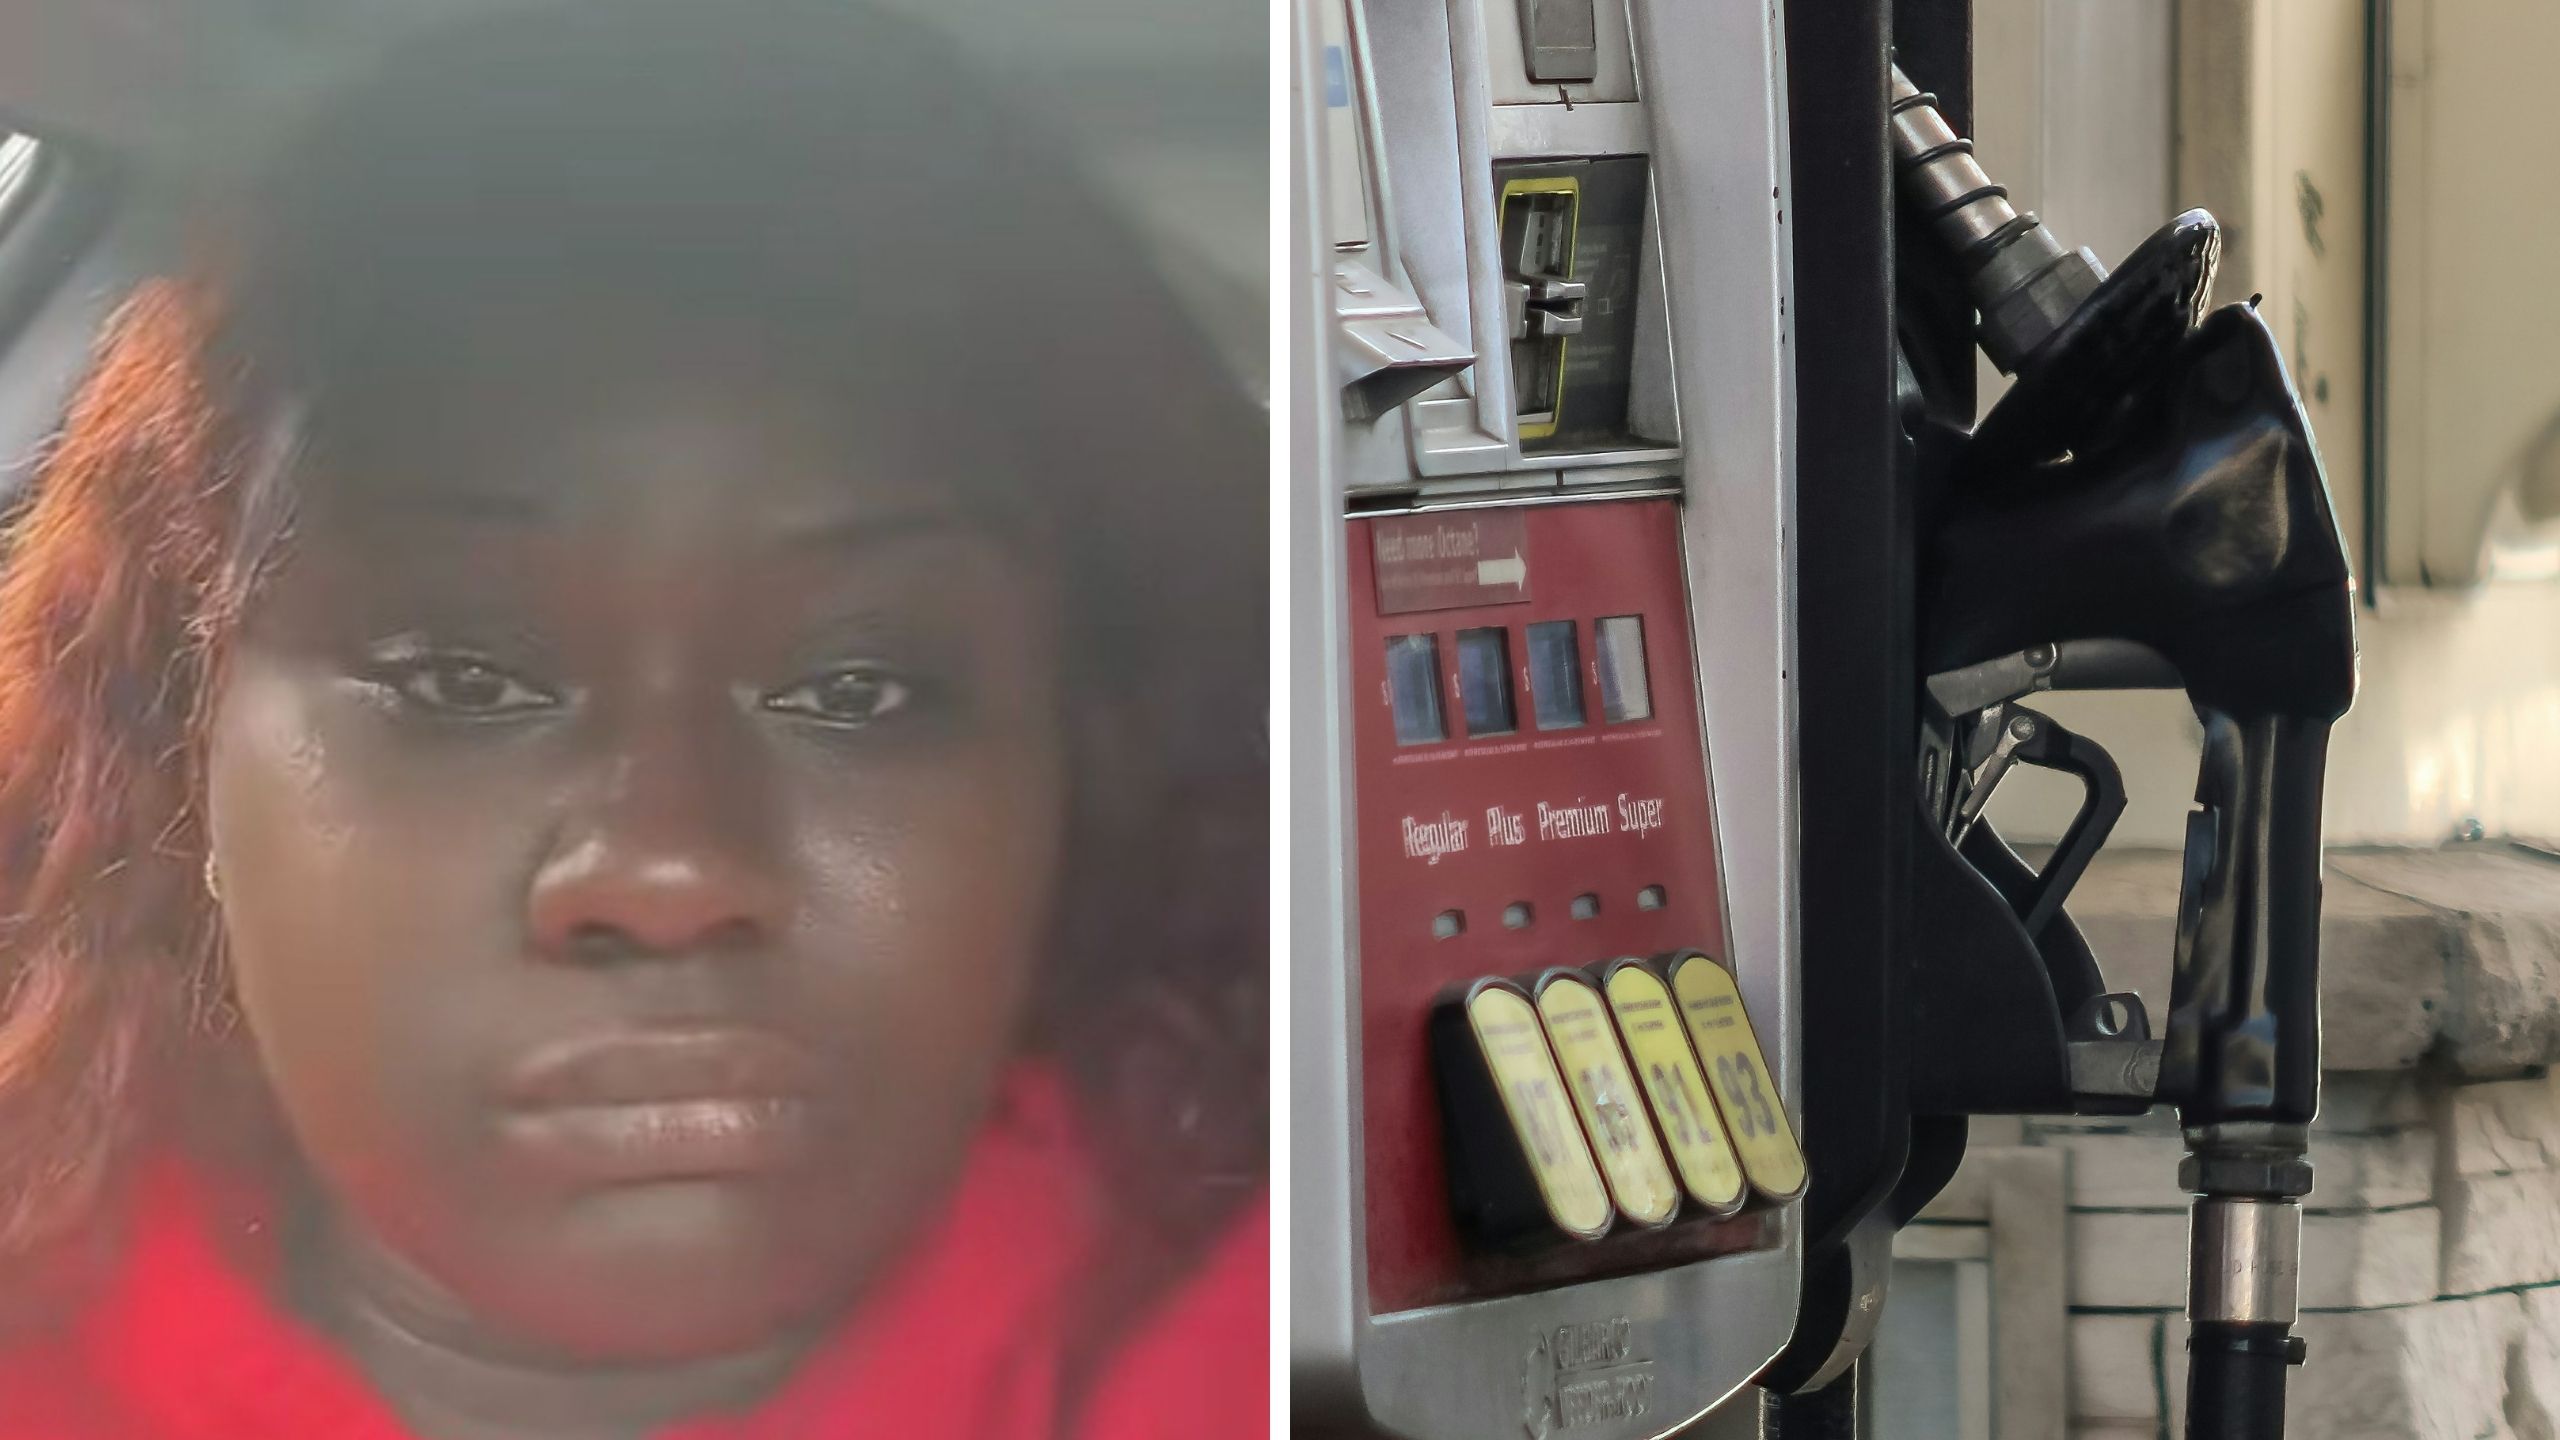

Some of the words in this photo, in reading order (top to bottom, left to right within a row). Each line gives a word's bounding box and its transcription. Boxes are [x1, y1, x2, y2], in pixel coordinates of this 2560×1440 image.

[1402, 811, 1469, 866] Regular
[1487, 805, 1525, 847] Plus
[1537, 796, 1610, 841] Premium
[1617, 793, 1664, 840] Super
[1716, 1051, 1777, 1139] 93
